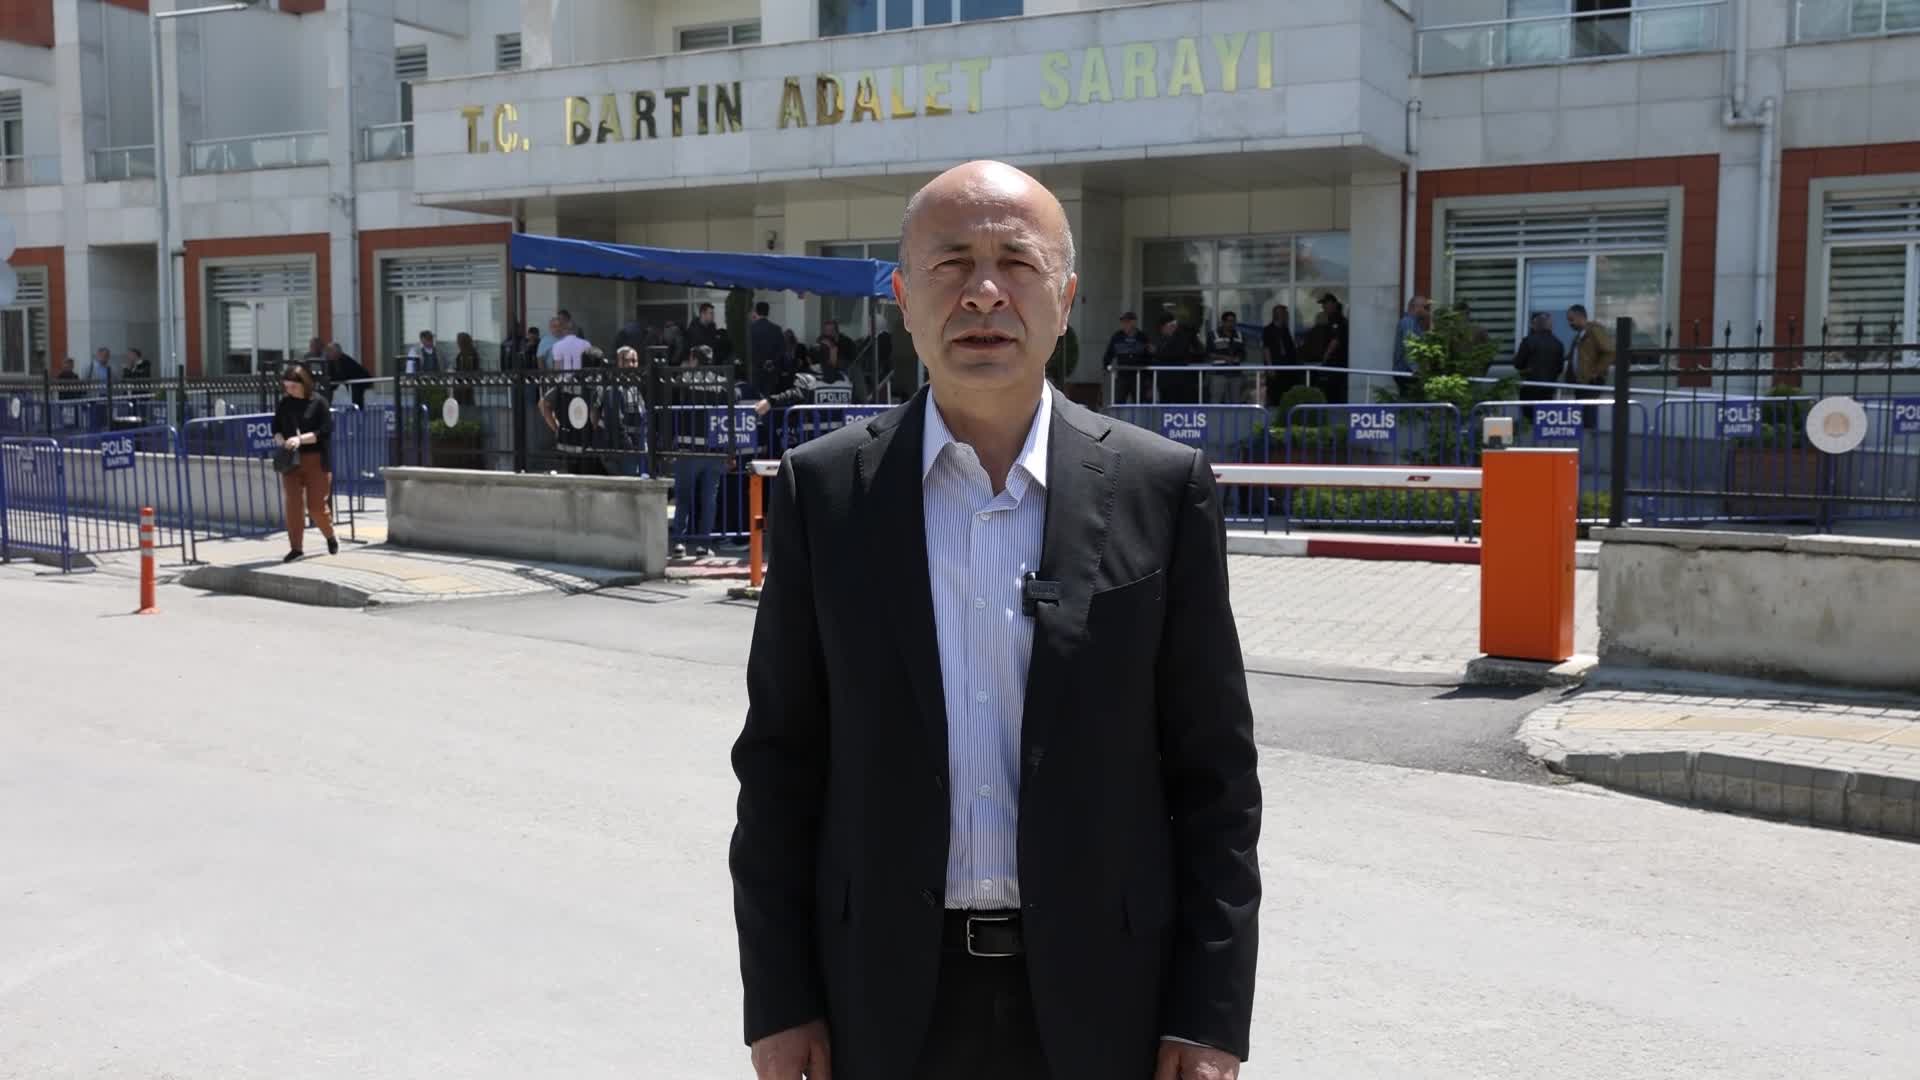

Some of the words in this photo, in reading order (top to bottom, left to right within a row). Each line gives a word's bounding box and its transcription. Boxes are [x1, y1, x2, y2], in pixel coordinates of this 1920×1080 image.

[461, 102, 530, 153] T.C.
[565, 81, 743, 146] BARTIN
[776, 55, 993, 129] ADALET
[1040, 31, 1274, 112] SARAYI
[1895, 404, 1920, 420] POL
[247, 422, 273, 438] POL
